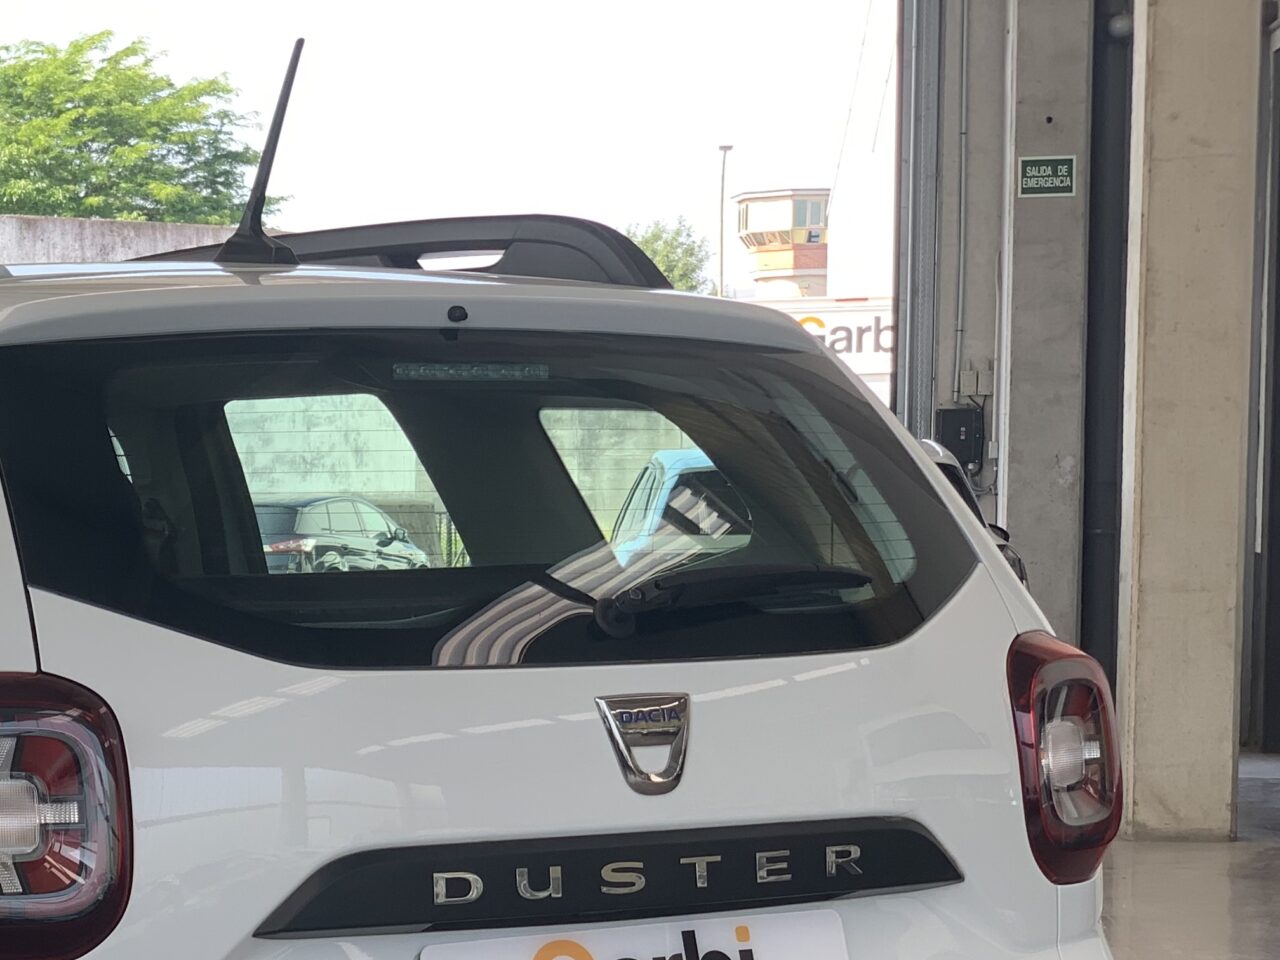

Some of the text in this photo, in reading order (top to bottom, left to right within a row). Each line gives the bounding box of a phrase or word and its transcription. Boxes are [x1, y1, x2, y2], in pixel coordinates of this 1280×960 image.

[1026, 165, 1068, 177] SALIDA DE
[1022, 176, 1071, 188] EMERGENCIA
[621, 708, 681, 723] DACIA
[433, 844, 863, 905] DUSTER
